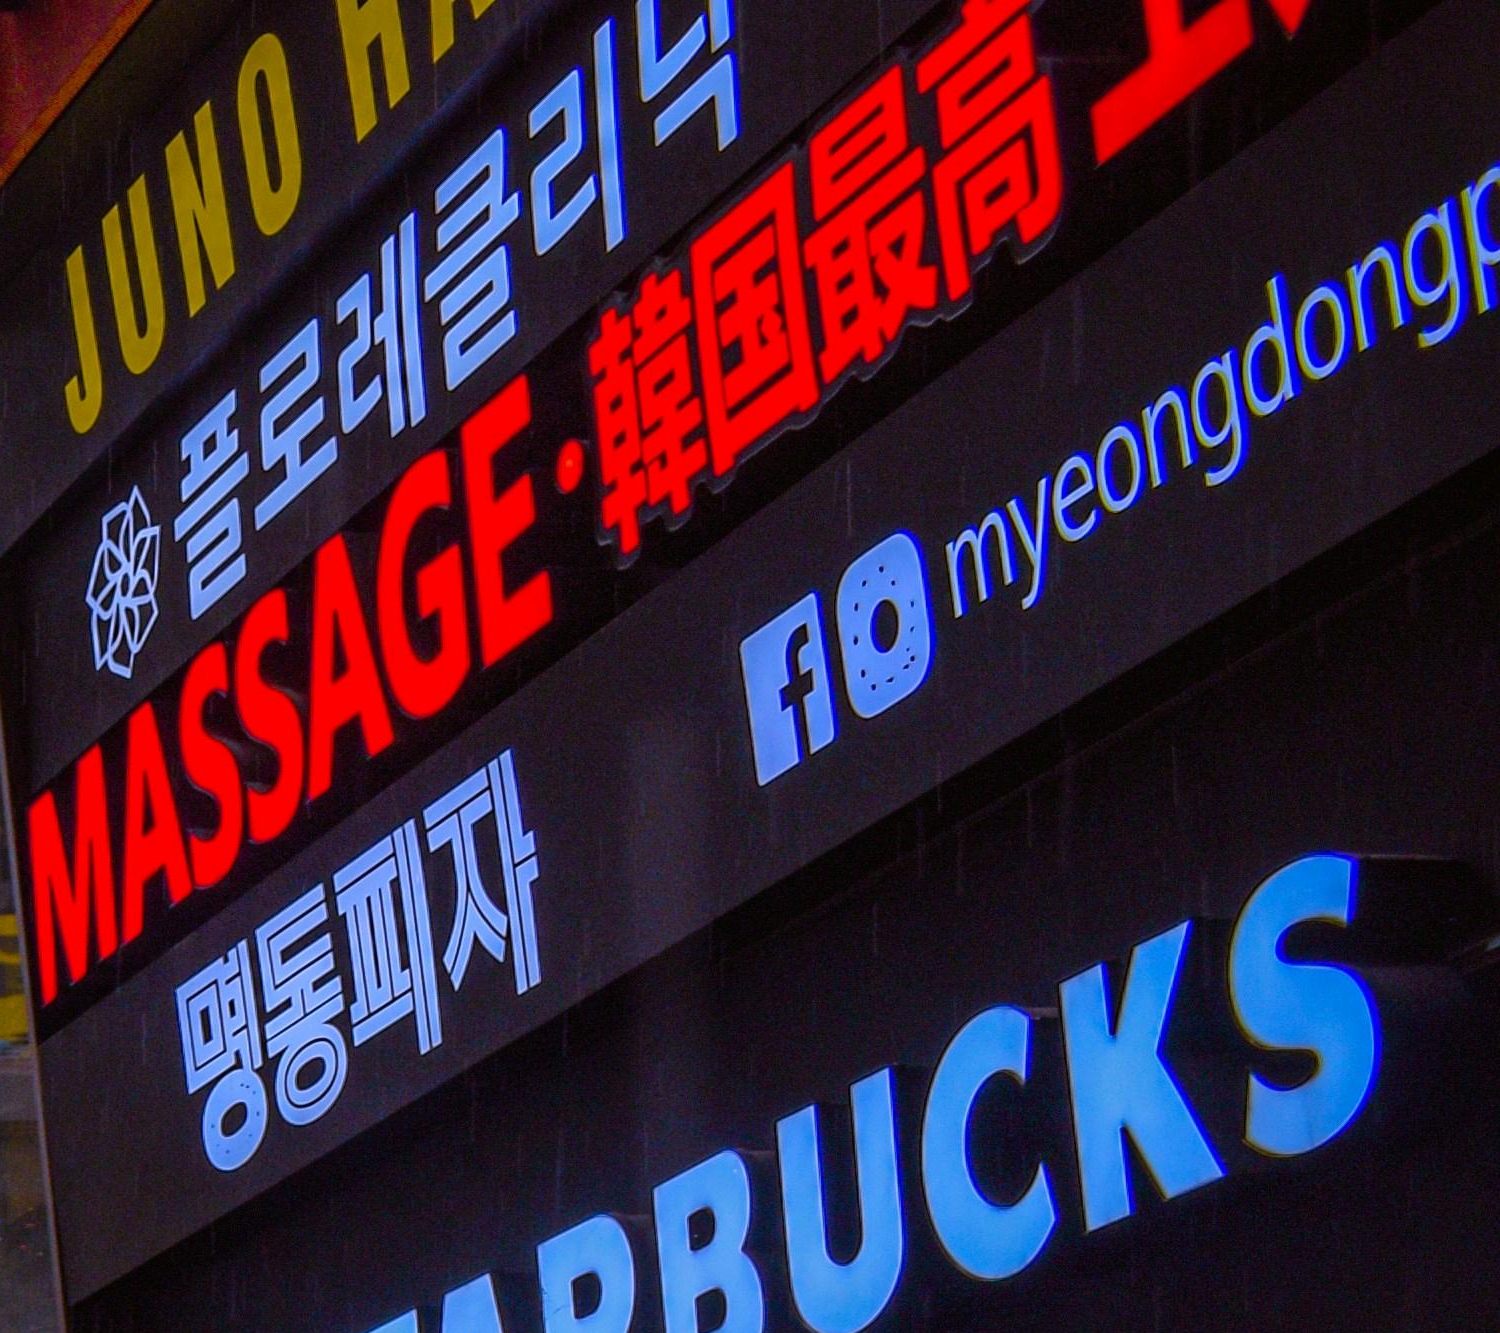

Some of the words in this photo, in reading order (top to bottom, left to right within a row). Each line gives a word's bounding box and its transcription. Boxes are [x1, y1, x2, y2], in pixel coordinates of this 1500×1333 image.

[63, 31, 303, 434] JUNO
[28, 373, 553, 1007] MASSAGE
[175, 749, 542, 1171] 명동피자
